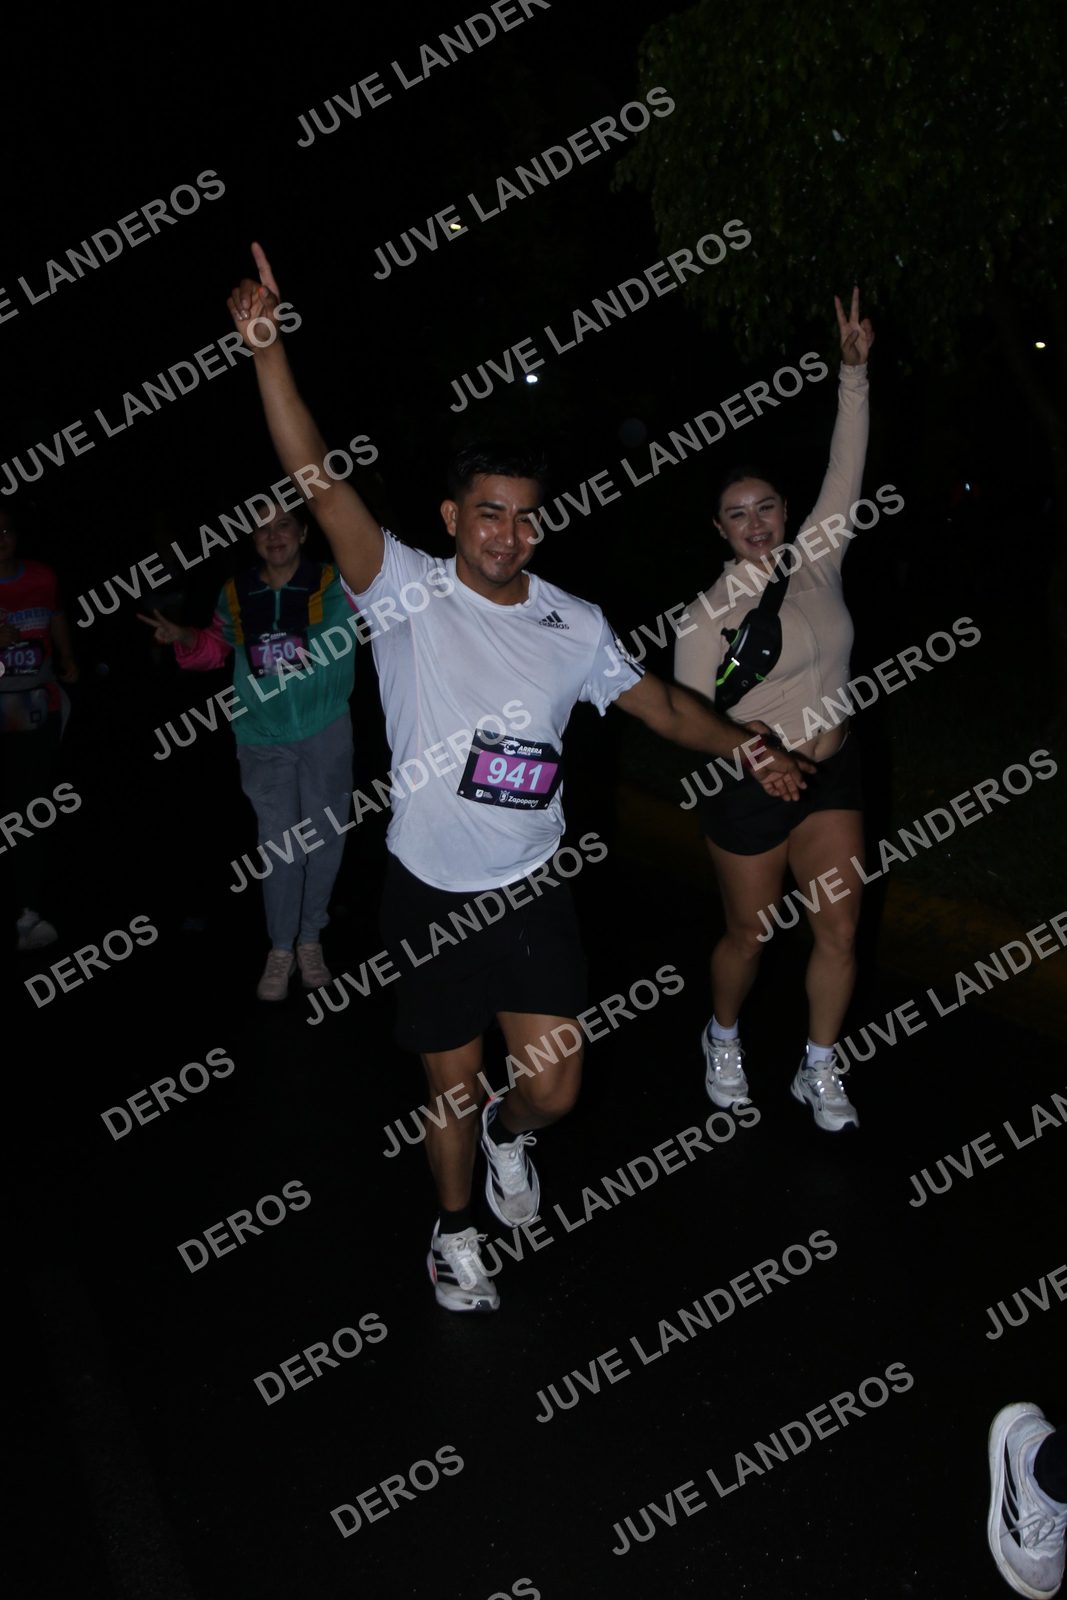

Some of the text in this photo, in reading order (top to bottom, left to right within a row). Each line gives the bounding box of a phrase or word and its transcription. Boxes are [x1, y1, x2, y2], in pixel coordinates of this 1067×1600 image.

[539, 620, 570, 630] adidas
[258, 641, 296, 667] 750
[487, 756, 543, 791] 941
